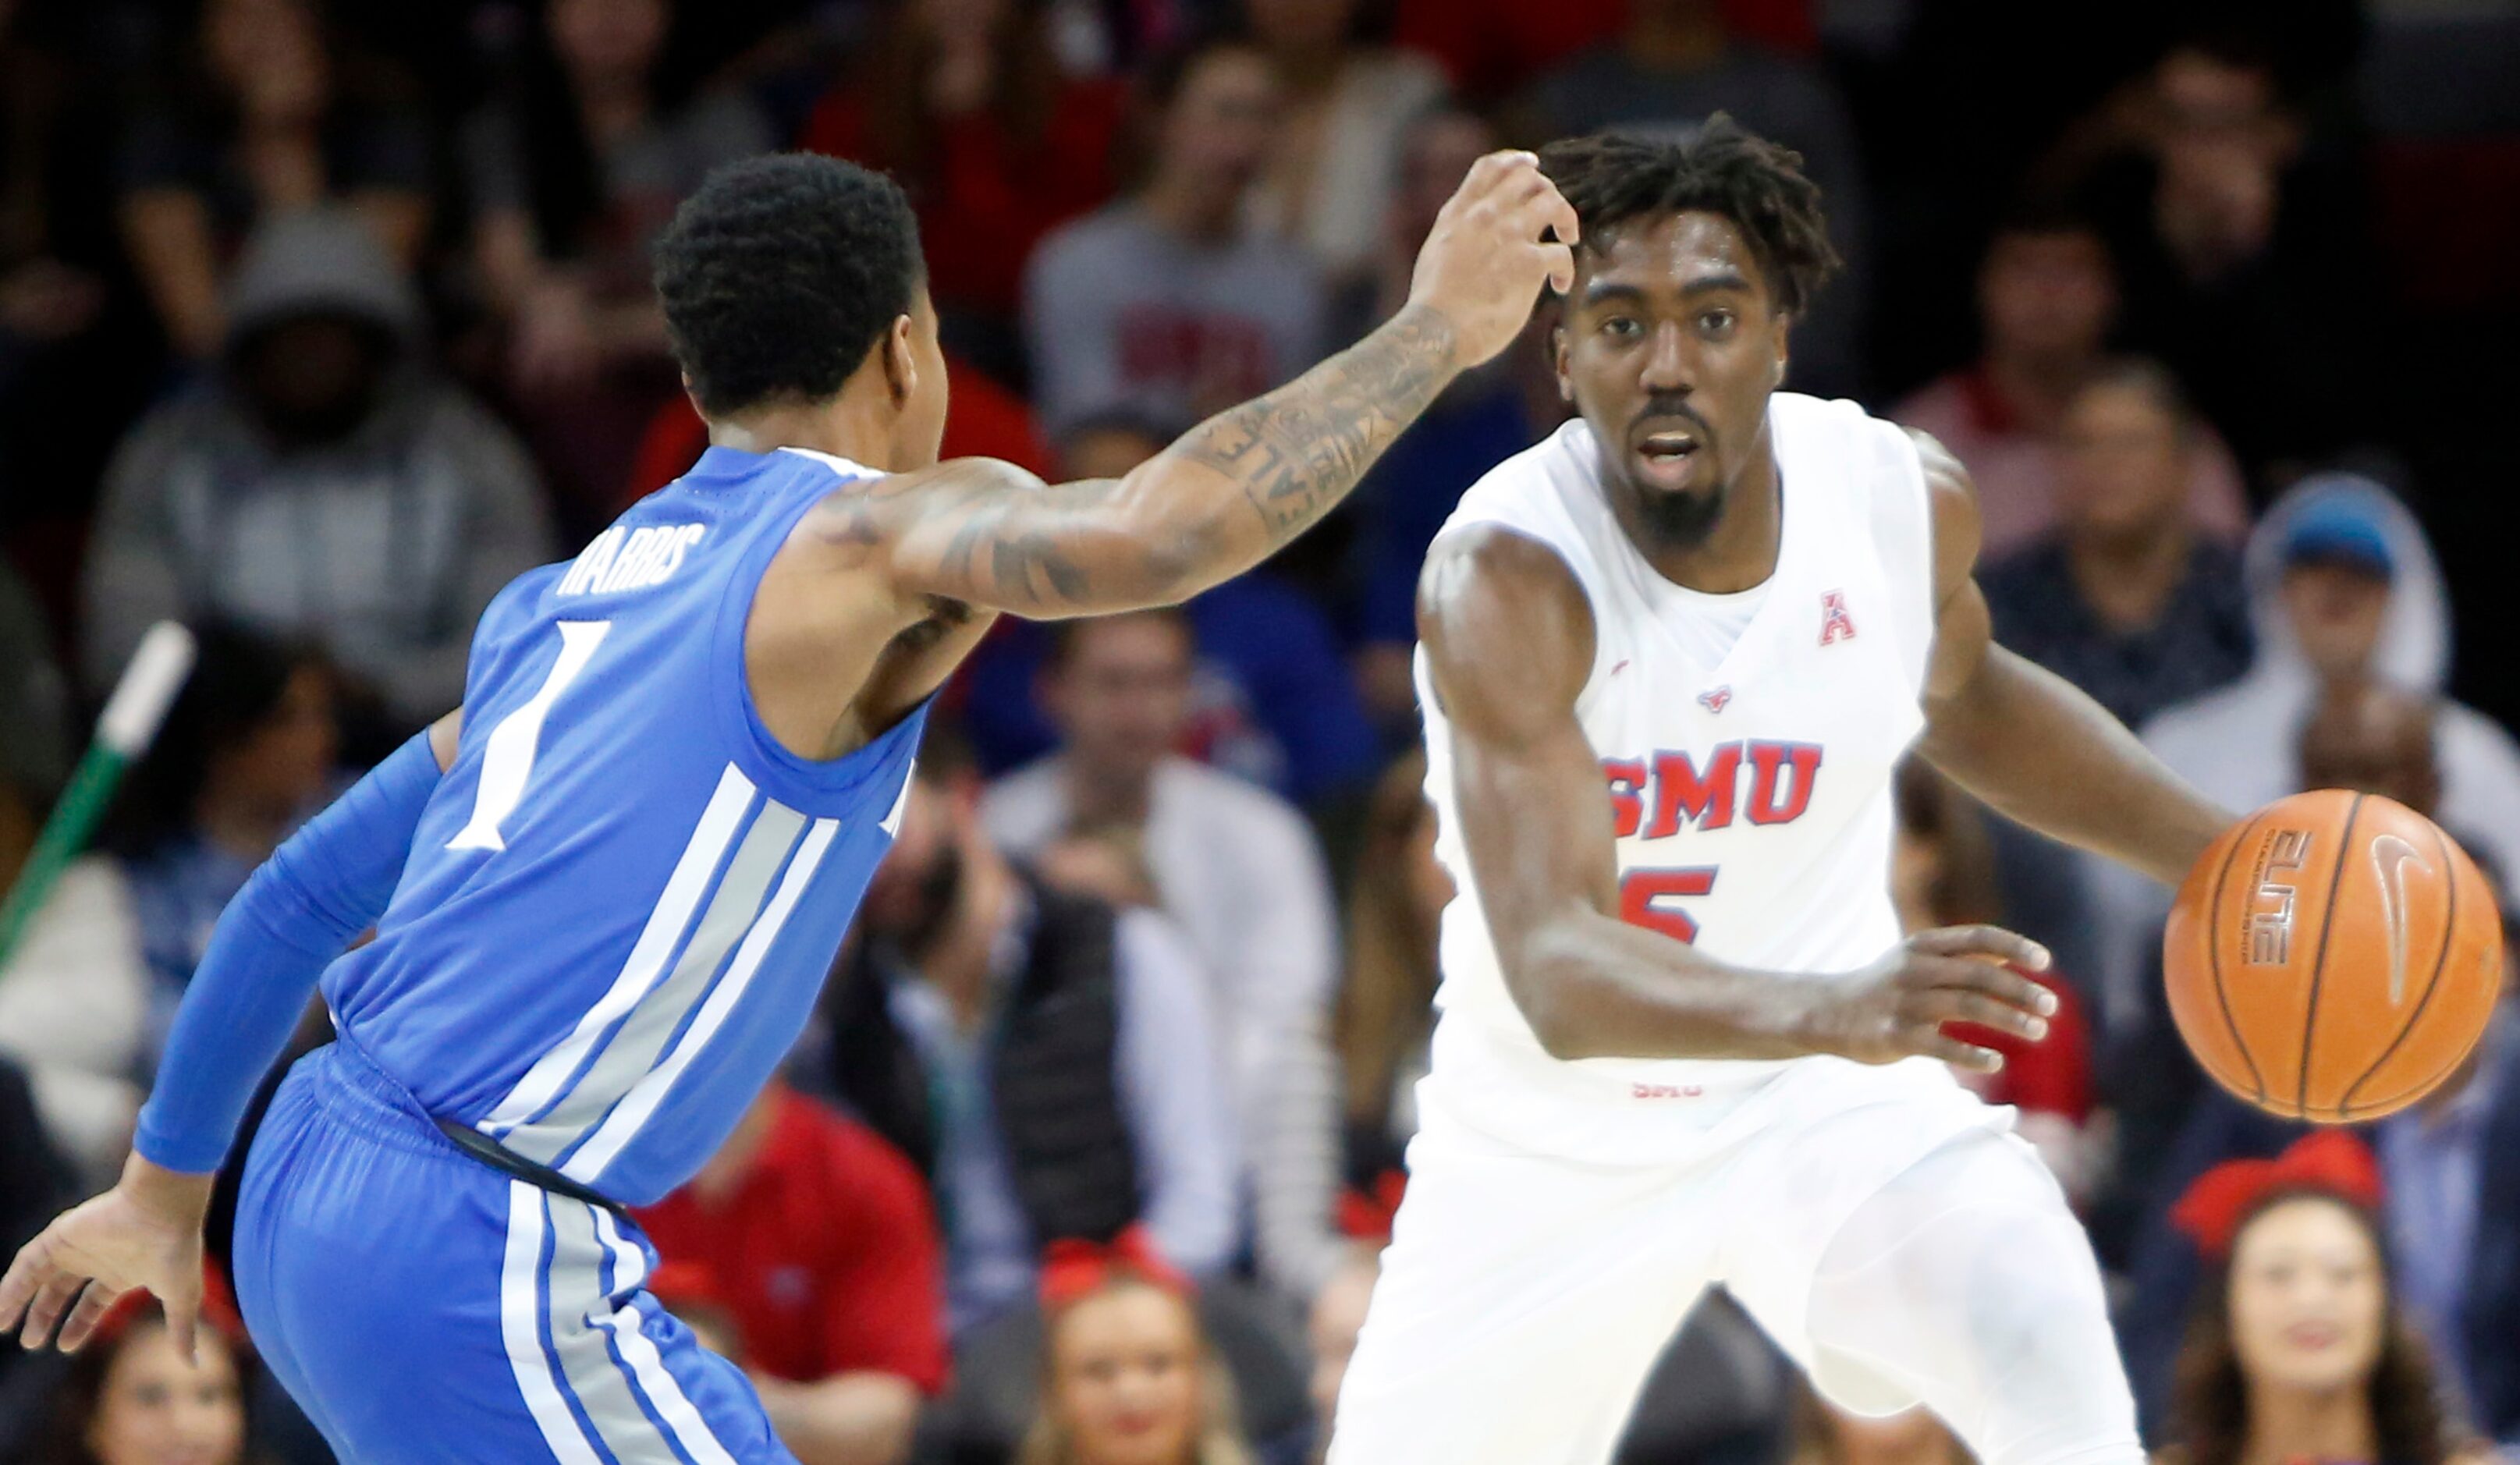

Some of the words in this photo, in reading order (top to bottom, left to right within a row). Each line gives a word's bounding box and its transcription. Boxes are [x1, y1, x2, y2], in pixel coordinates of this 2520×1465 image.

[555, 522, 706, 596] HARRIS
[444, 621, 612, 851] 1
[1596, 737, 1824, 840] SMU
[2252, 830, 2312, 965] ELITE
